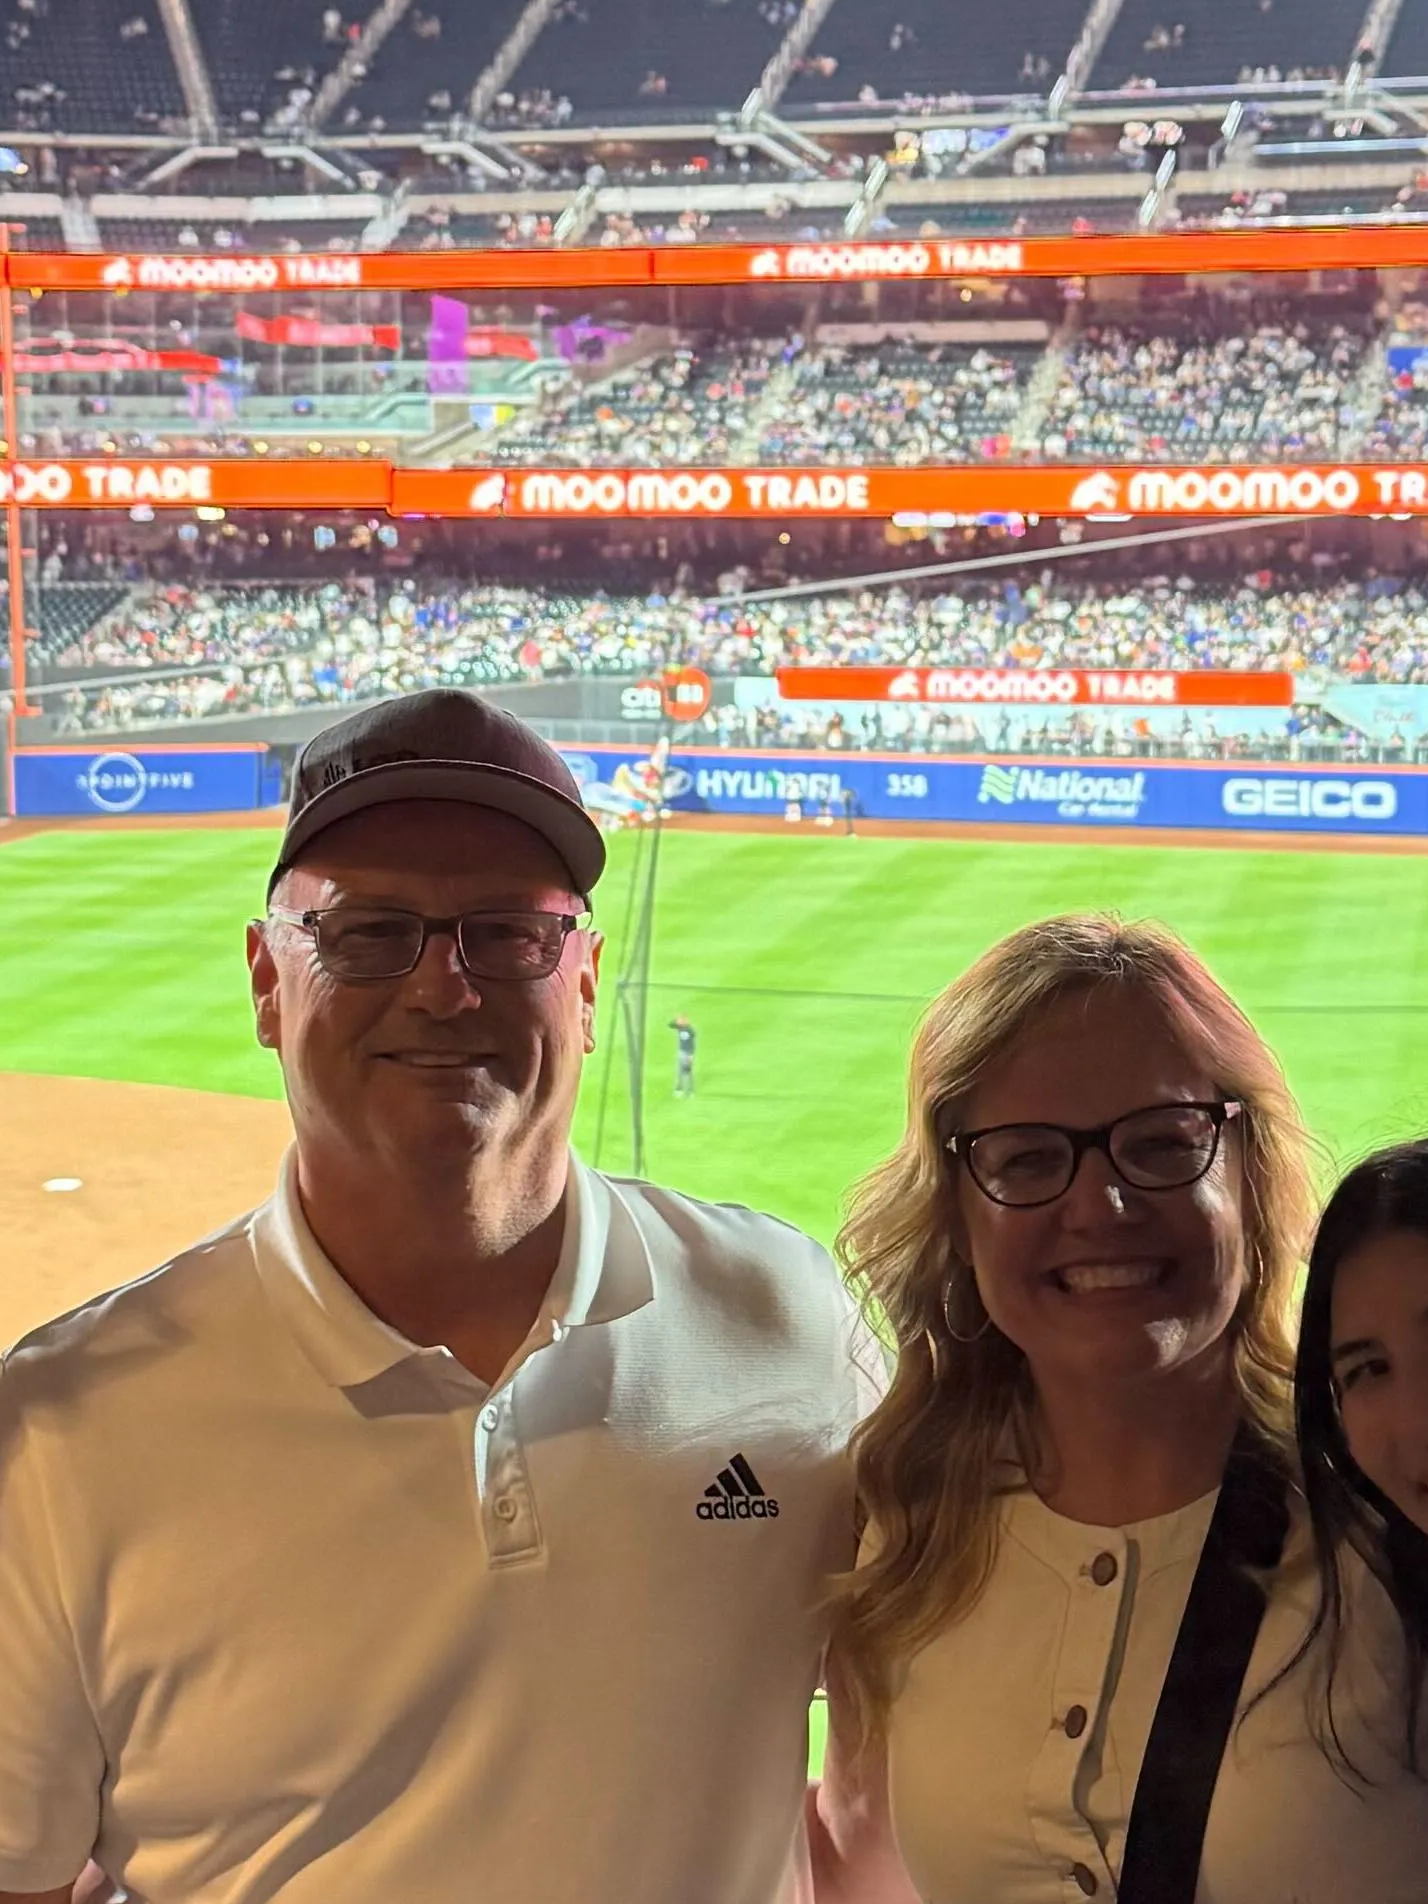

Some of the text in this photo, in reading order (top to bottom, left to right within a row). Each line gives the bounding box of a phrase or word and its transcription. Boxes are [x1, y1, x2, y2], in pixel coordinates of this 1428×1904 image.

[284, 259, 361, 285] TRADE
[937, 241, 1022, 271] TRADE
[83, 467, 211, 501] TRADE
[743, 475, 869, 509] TRADE
[1087, 673, 1175, 702] TRADE
[1016, 771, 1145, 805] National
[1222, 777, 1397, 819] GEICO
[696, 1495, 780, 1520] adidas
